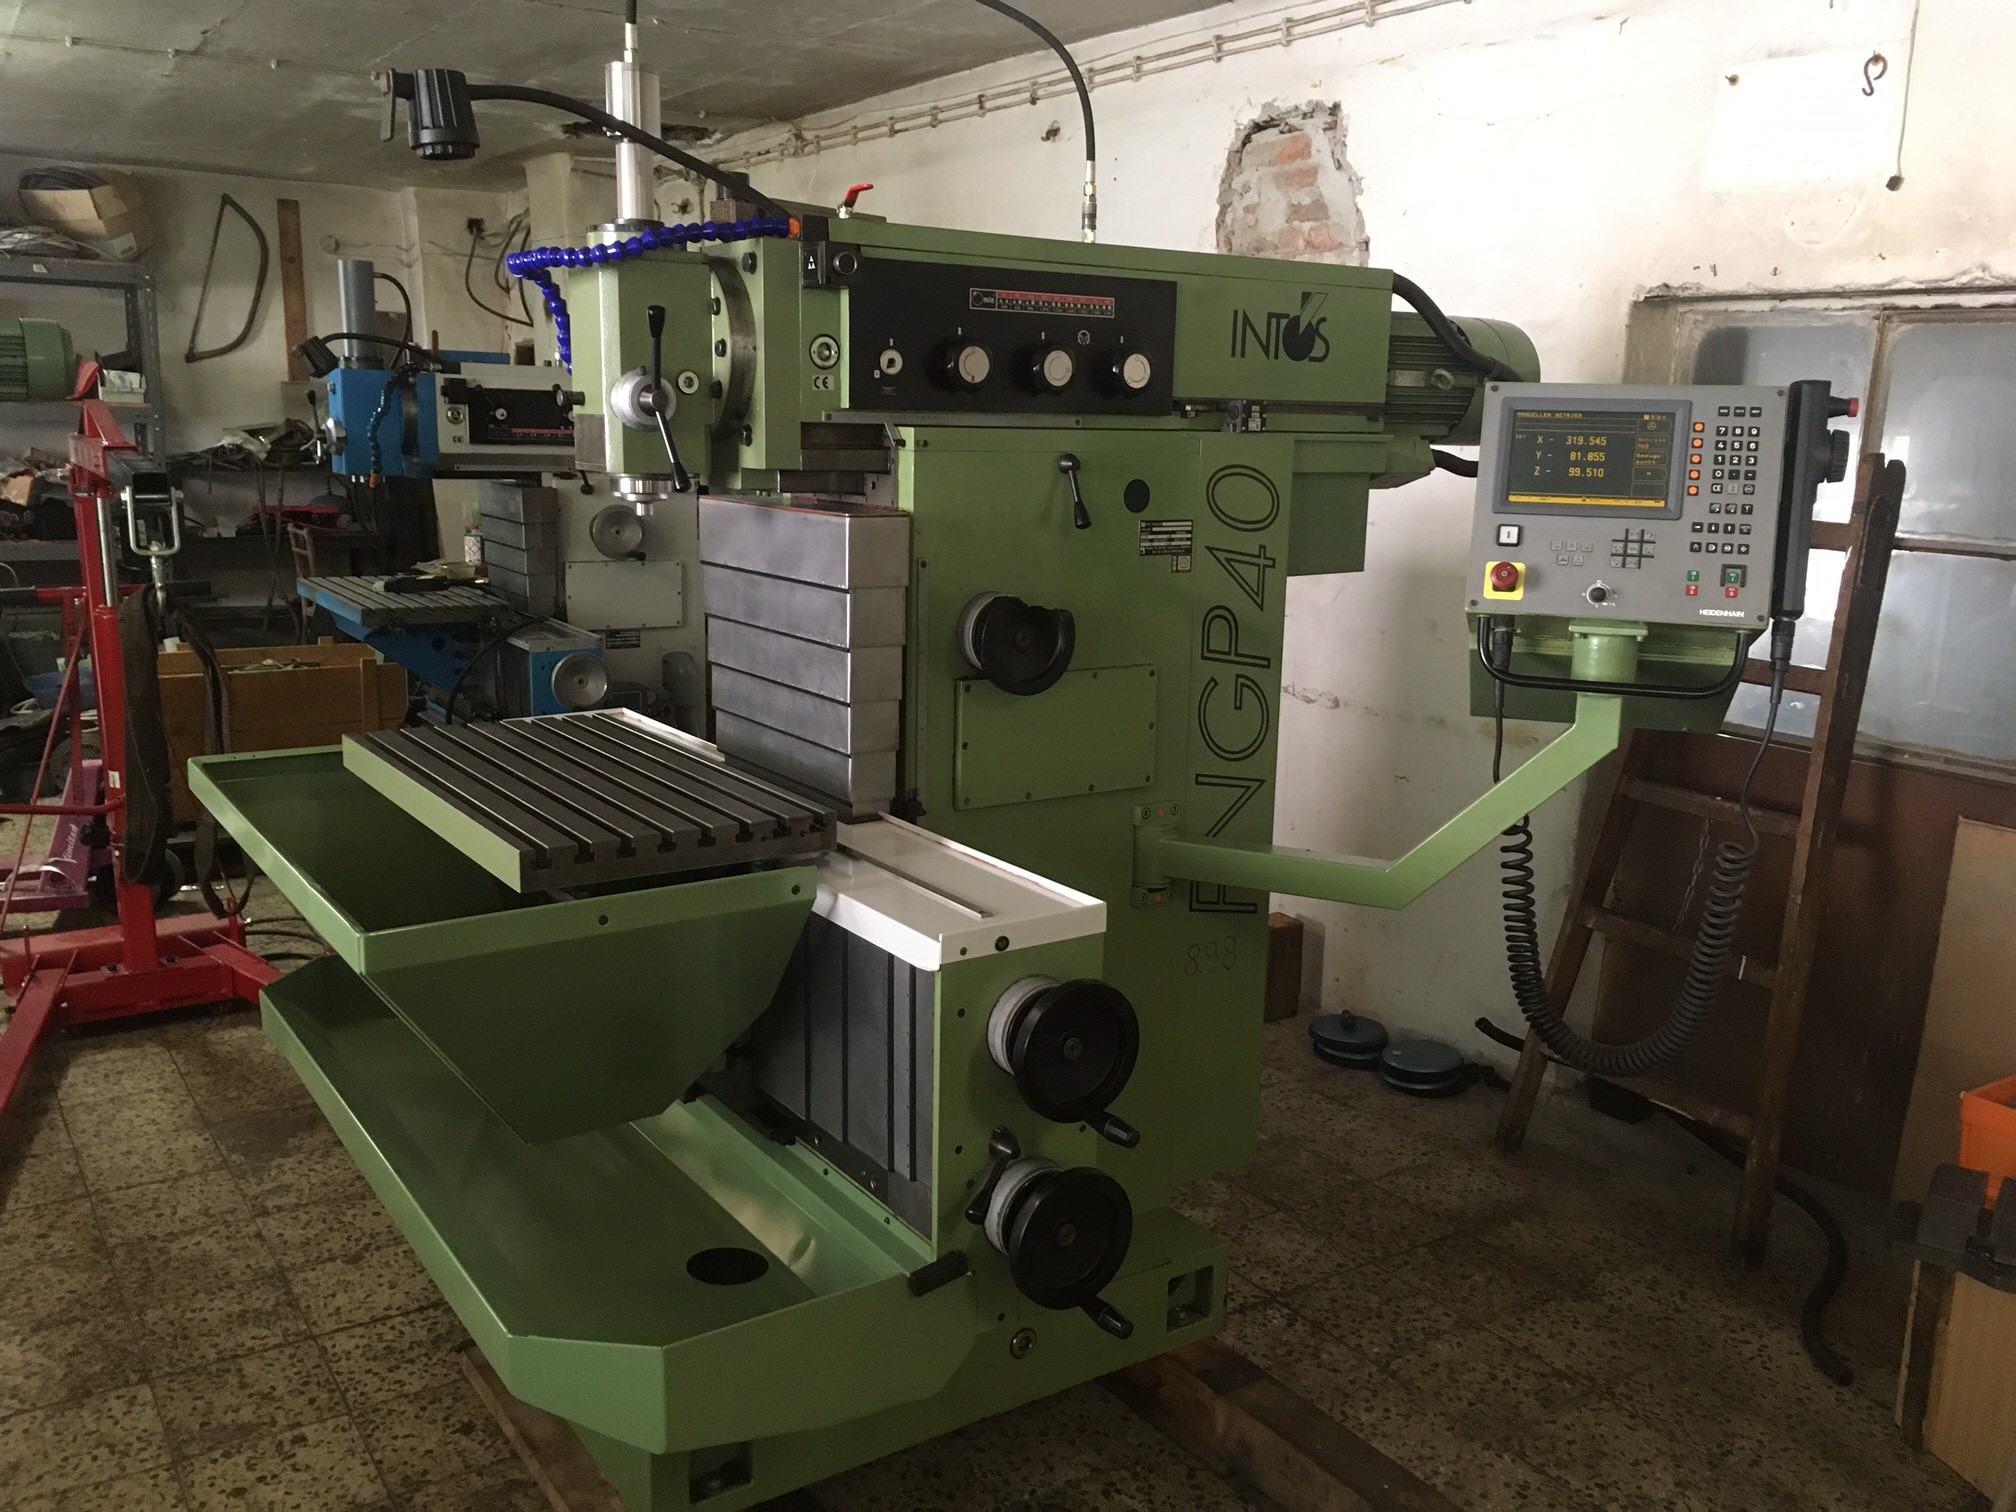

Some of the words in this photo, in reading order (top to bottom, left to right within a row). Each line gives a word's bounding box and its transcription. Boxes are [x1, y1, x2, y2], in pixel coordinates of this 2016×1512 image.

[1231, 291, 1330, 362] INTOS
[1536, 435, 1544, 444] X
[1566, 435, 1607, 446] 319.545
[1536, 451, 1542, 460] Y
[1570, 451, 1606, 461] 81.855
[1732, 456, 1739, 464] 2
[1534, 466, 1540, 476] Z
[1568, 467, 1605, 478] 99.510
[1712, 484, 1722, 492] CE
[1699, 608, 1745, 618] HEIDENHAIN
